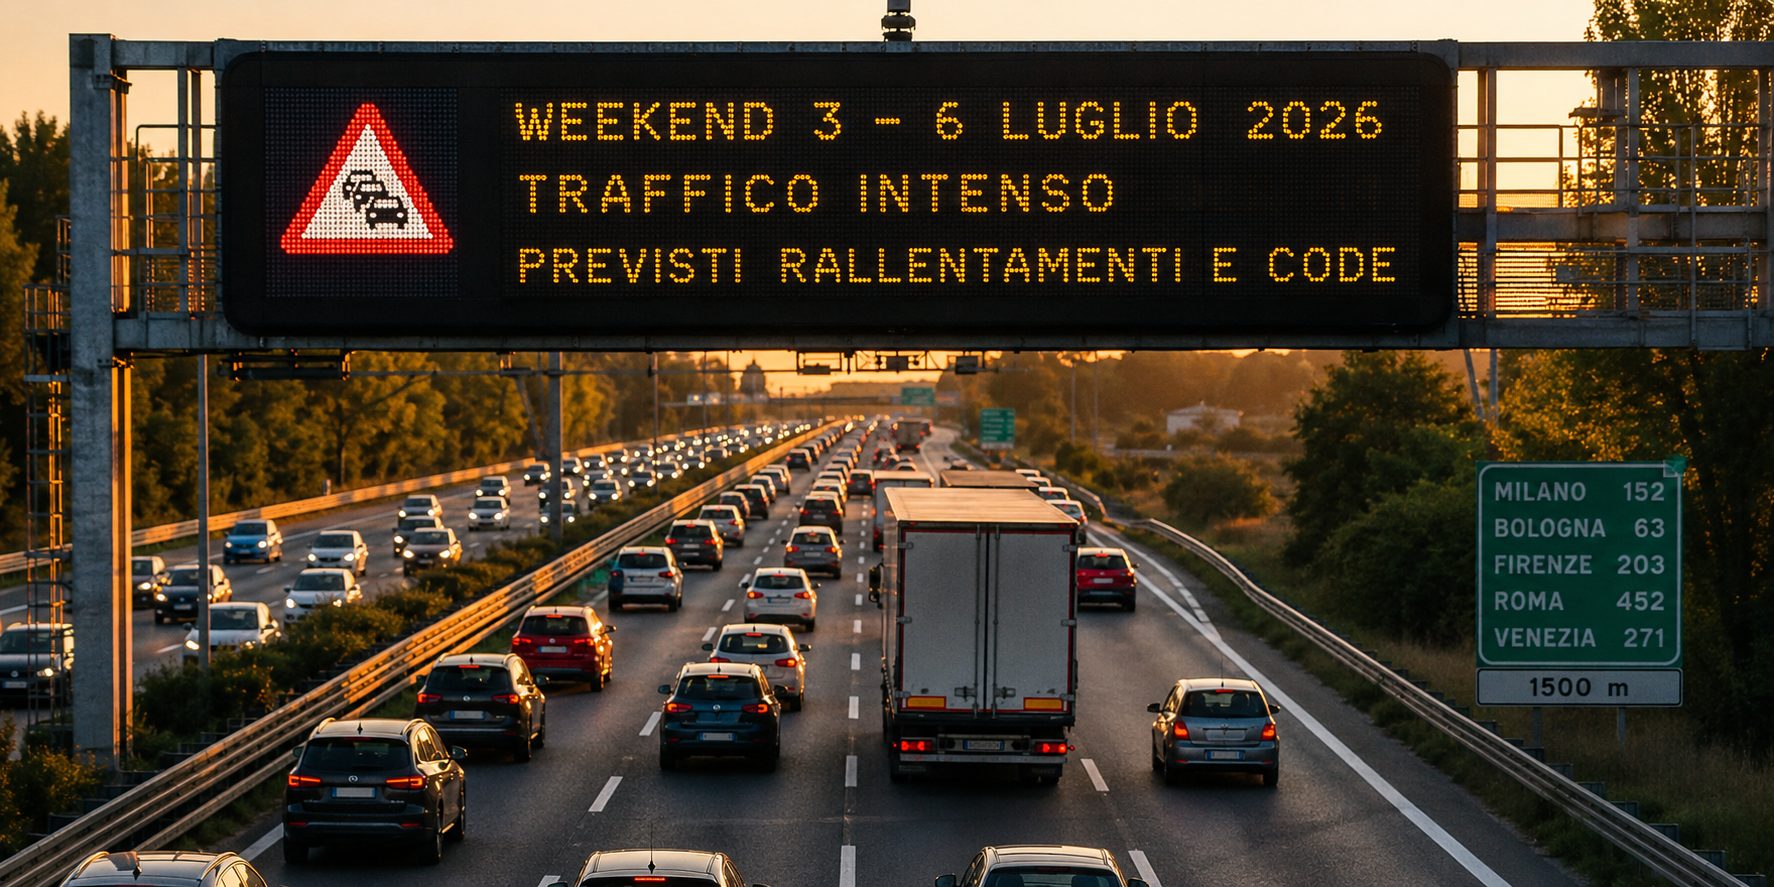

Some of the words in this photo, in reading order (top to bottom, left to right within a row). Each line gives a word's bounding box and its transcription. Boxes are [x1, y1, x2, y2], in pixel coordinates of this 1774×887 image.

[514, 101, 774, 141] WEEKEND
[813, 101, 842, 141] 3
[935, 101, 964, 141] 6
[1002, 101, 1198, 140] LUGLIO
[1247, 100, 1383, 140] 2026
[519, 173, 819, 214] TRAFFICO
[860, 173, 1114, 213] INTENSO
[519, 247, 742, 284] PREVISTI
[780, 247, 1181, 284] RALLENTAMENTI
[1213, 247, 1238, 283] E
[1268, 246, 1396, 283] CODE
[1495, 482, 1587, 502] MILANO
[1623, 482, 1665, 502] 152
[1495, 518, 1606, 538] BOLOGNA
[1634, 518, 1665, 538] 63
[1495, 555, 1593, 575] FIRENZE
[1617, 555, 1665, 575] 203
[1495, 591, 1565, 611] ROMA
[1616, 591, 1665, 611] 452
[1495, 628, 1597, 648] VENEZIA
[1624, 628, 1664, 648] 271
[1529, 677, 1592, 697] 1500
[1607, 681, 1629, 697] m
